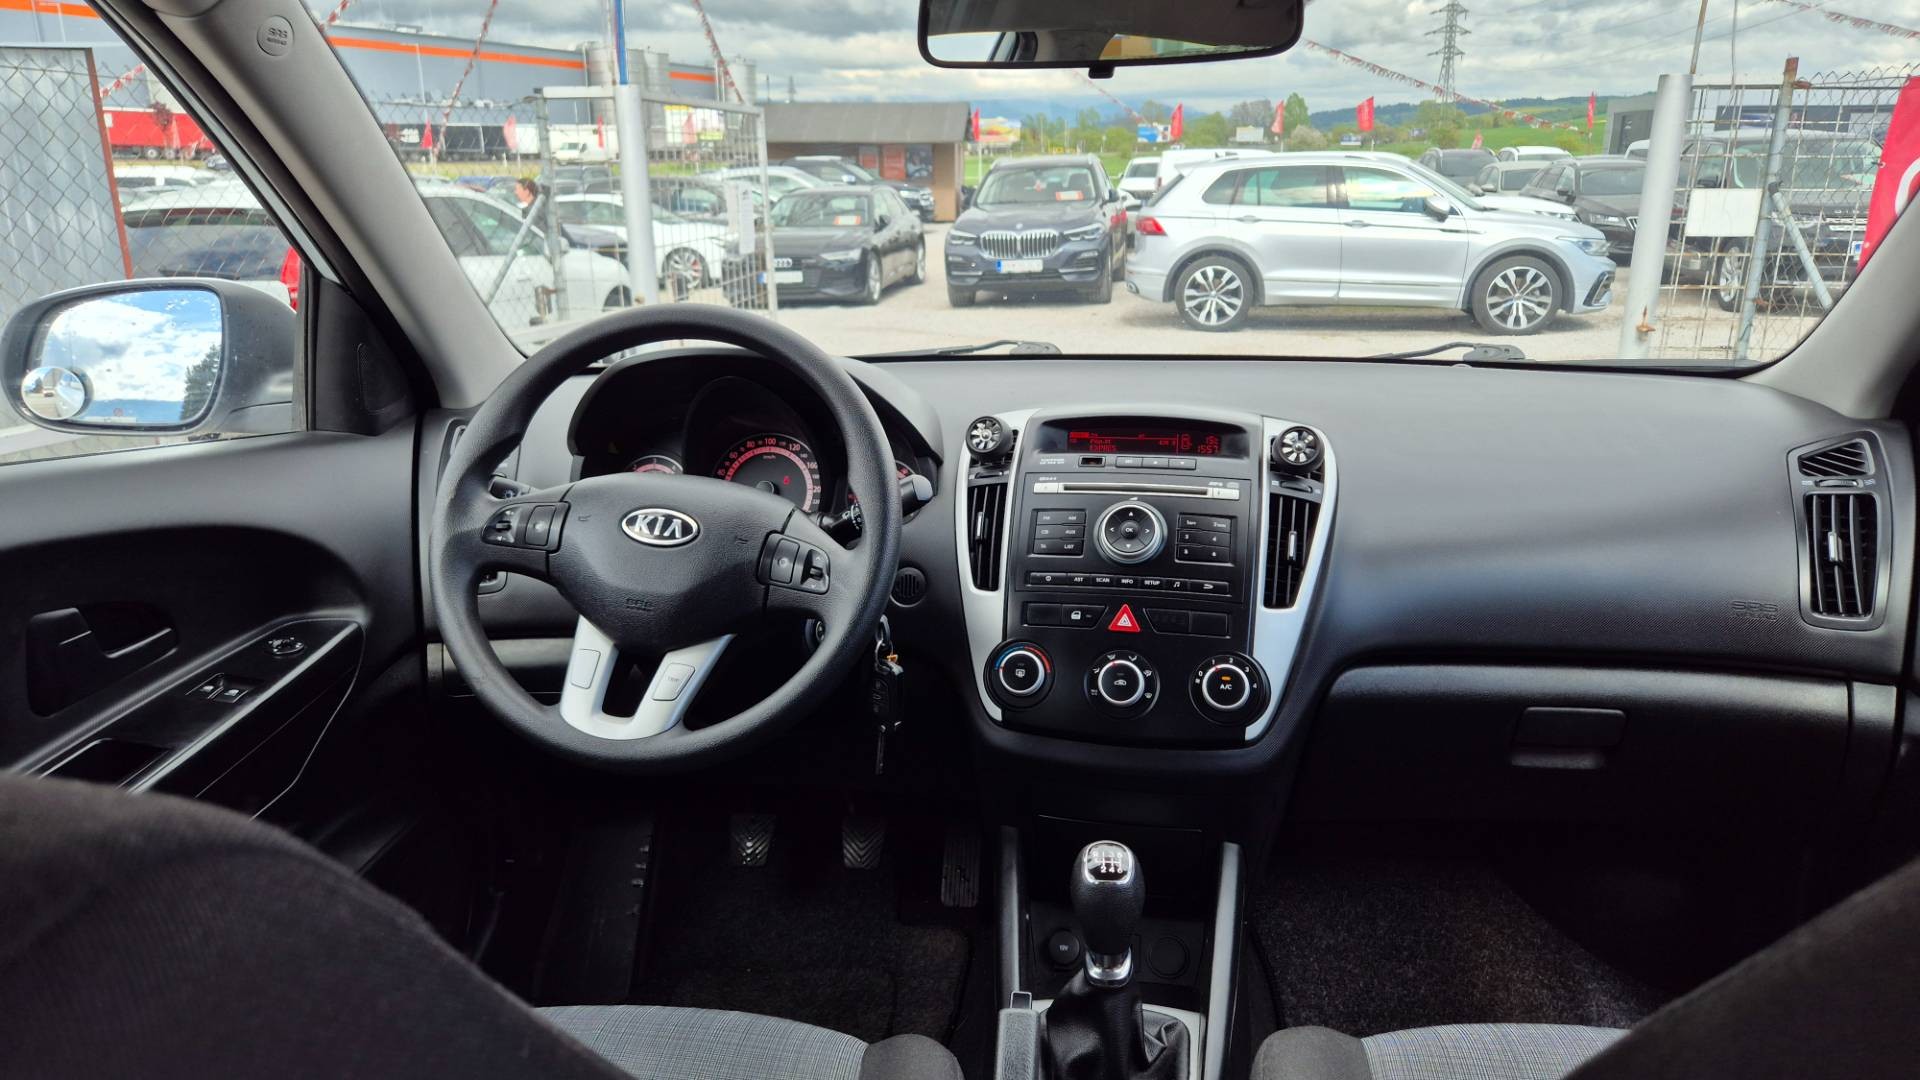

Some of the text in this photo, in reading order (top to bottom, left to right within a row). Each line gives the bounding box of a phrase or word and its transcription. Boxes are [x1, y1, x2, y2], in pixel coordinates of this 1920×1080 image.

[764, 438, 777, 446] 100
[788, 443, 801, 452] 120
[807, 461, 818, 470] 160
[634, 514, 683, 539] KIA
[1220, 683, 1233, 691] A/C
